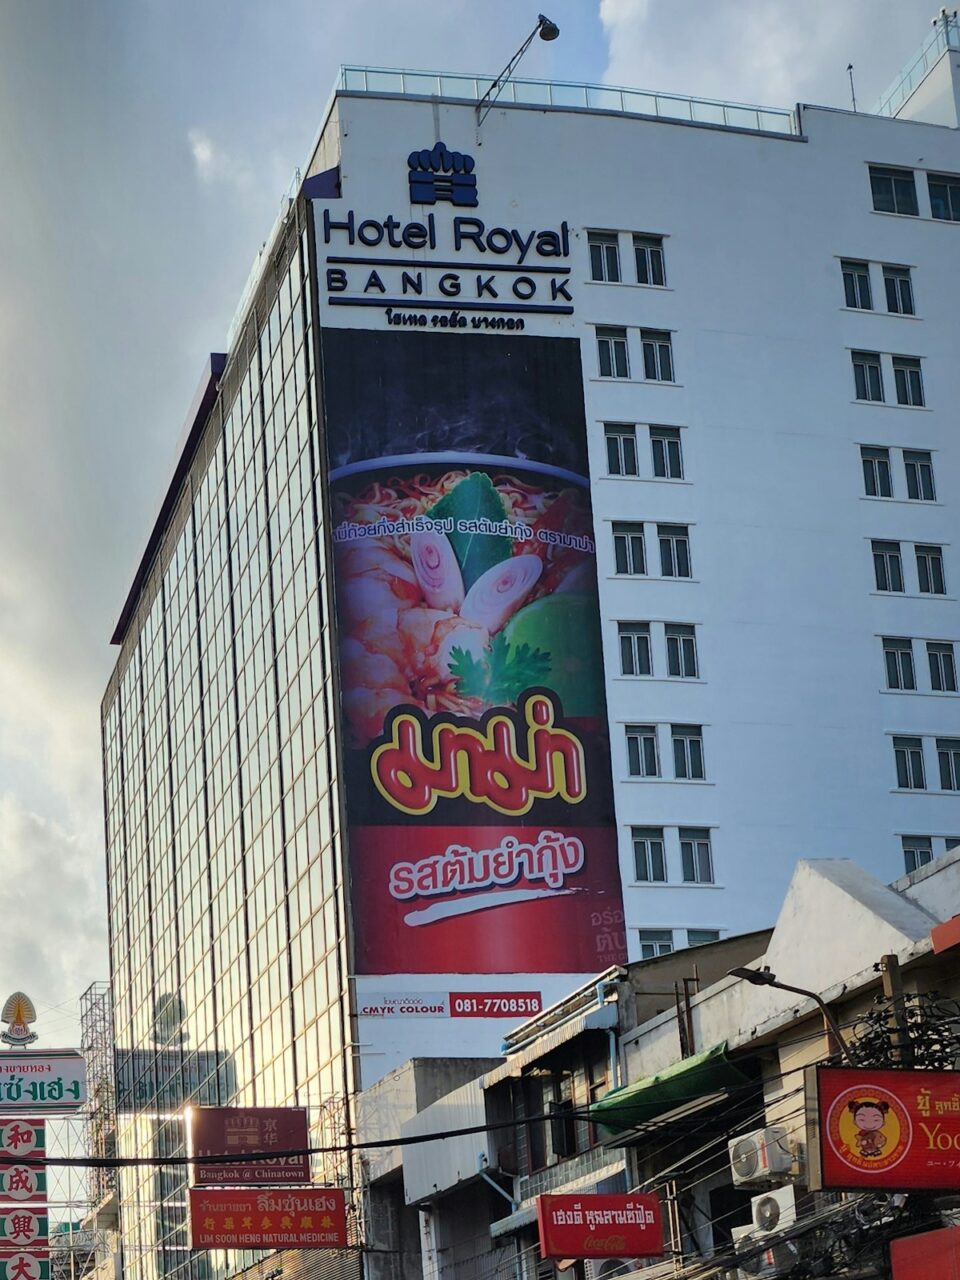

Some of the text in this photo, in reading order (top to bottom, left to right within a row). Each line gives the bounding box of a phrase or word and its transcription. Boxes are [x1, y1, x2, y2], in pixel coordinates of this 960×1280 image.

[324, 209, 569, 264] Hotel Royal
[326, 268, 573, 301] BANGKOK
[391, 832, 583, 898] รสต้มยำกุ้ง
[362, 1005, 444, 1014] CMYK COLOUR
[455, 998, 539, 1013] 081-7708518
[200, 1168, 304, 1181] Bangkok @ Chinatown
[199, 1232, 339, 1243] LIM SOON HENG NATURAL MEDICINE
